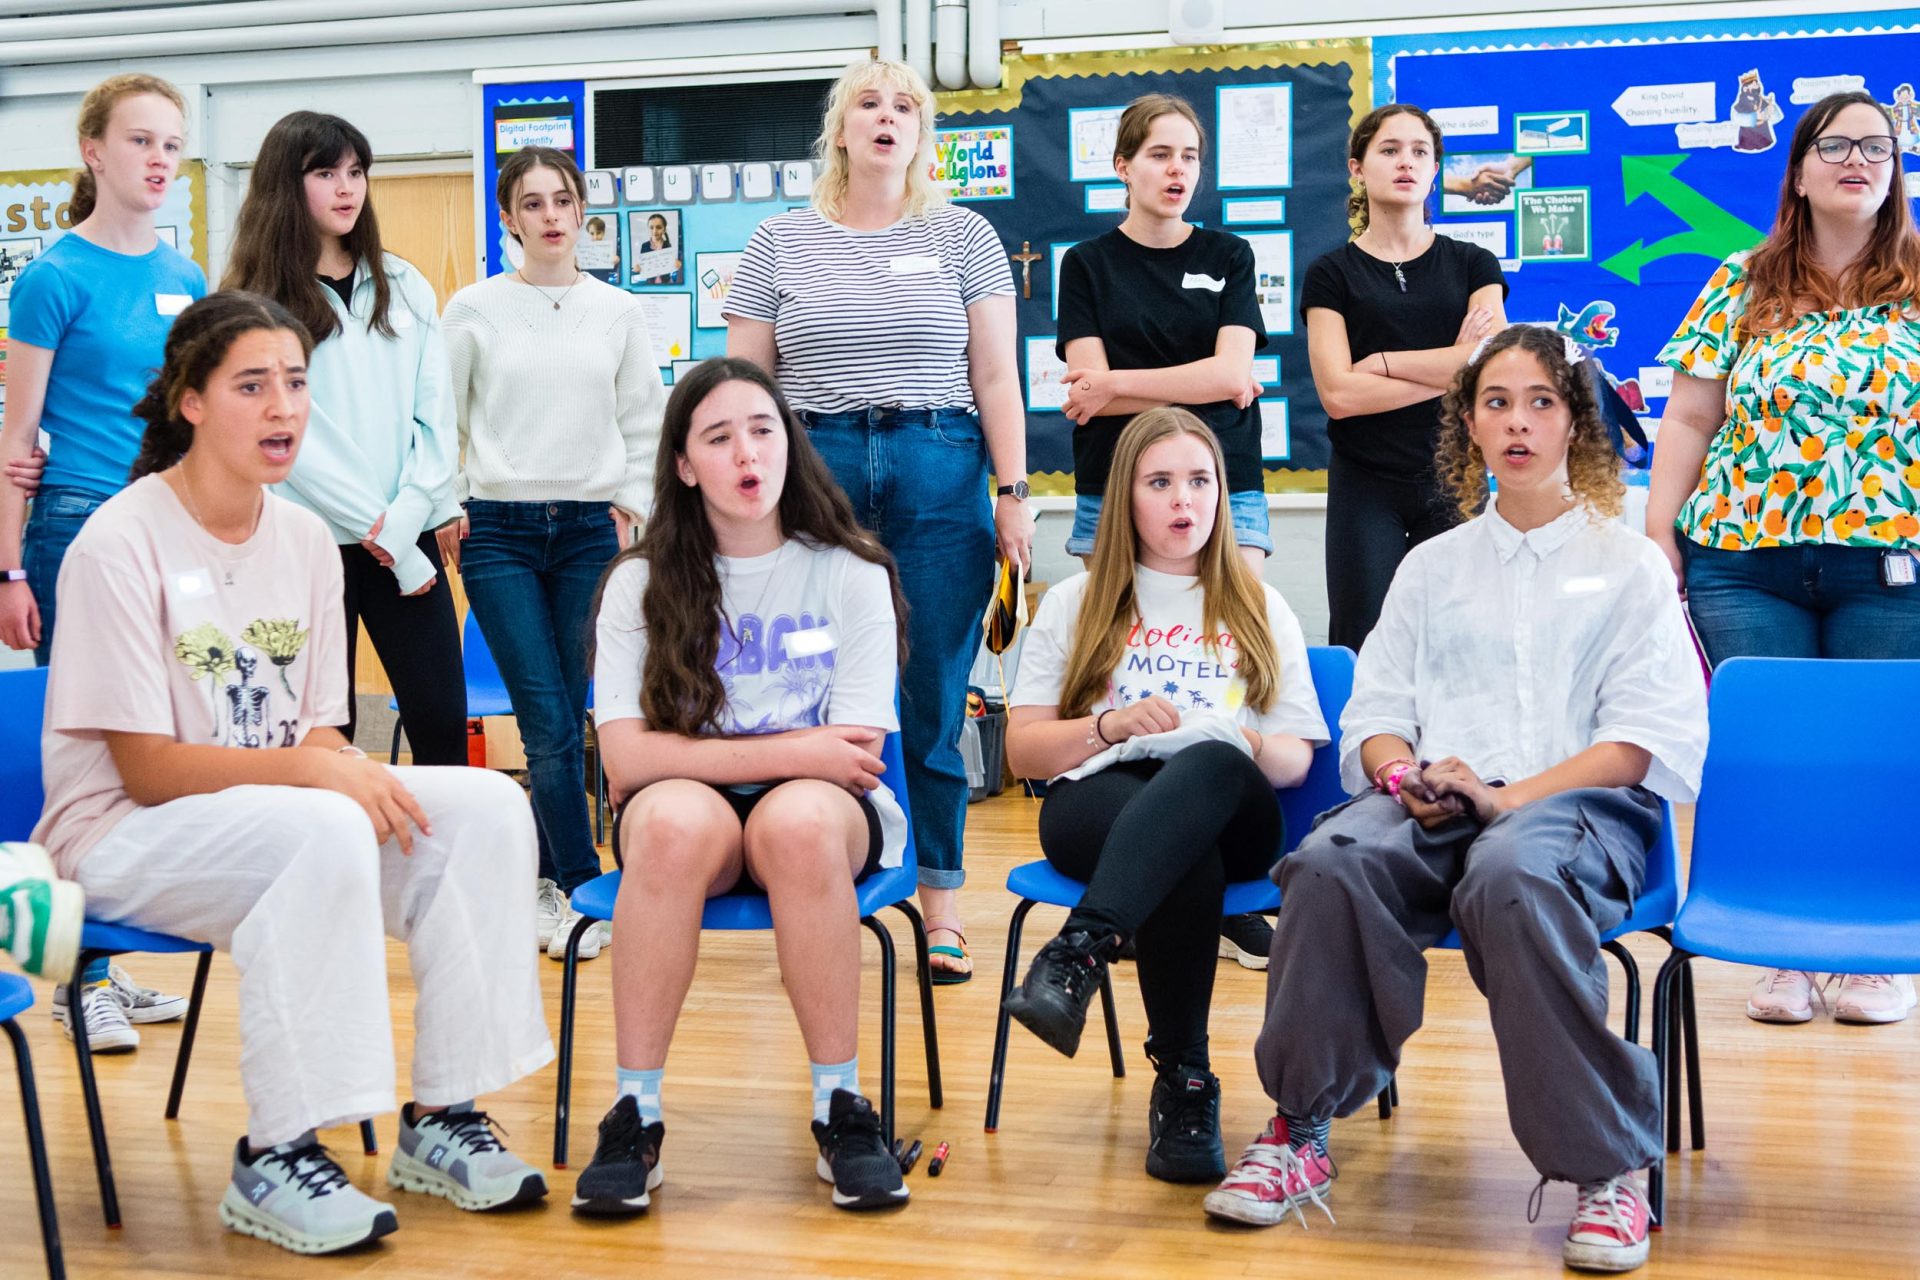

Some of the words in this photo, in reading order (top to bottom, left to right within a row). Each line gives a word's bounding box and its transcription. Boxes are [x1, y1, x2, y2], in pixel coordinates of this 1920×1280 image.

[1661, 91, 1684, 100] David
[500, 124, 526, 134] Digital
[528, 122, 567, 132] Footprint
[935, 140, 994, 163] World
[1522, 196, 1542, 206] The
[1544, 195, 1582, 204] Choices
[0, 195, 74, 233] sto
[1531, 204, 1546, 214] We
[1548, 204, 1575, 213] Make
[1127, 653, 1229, 679] MOTEL
